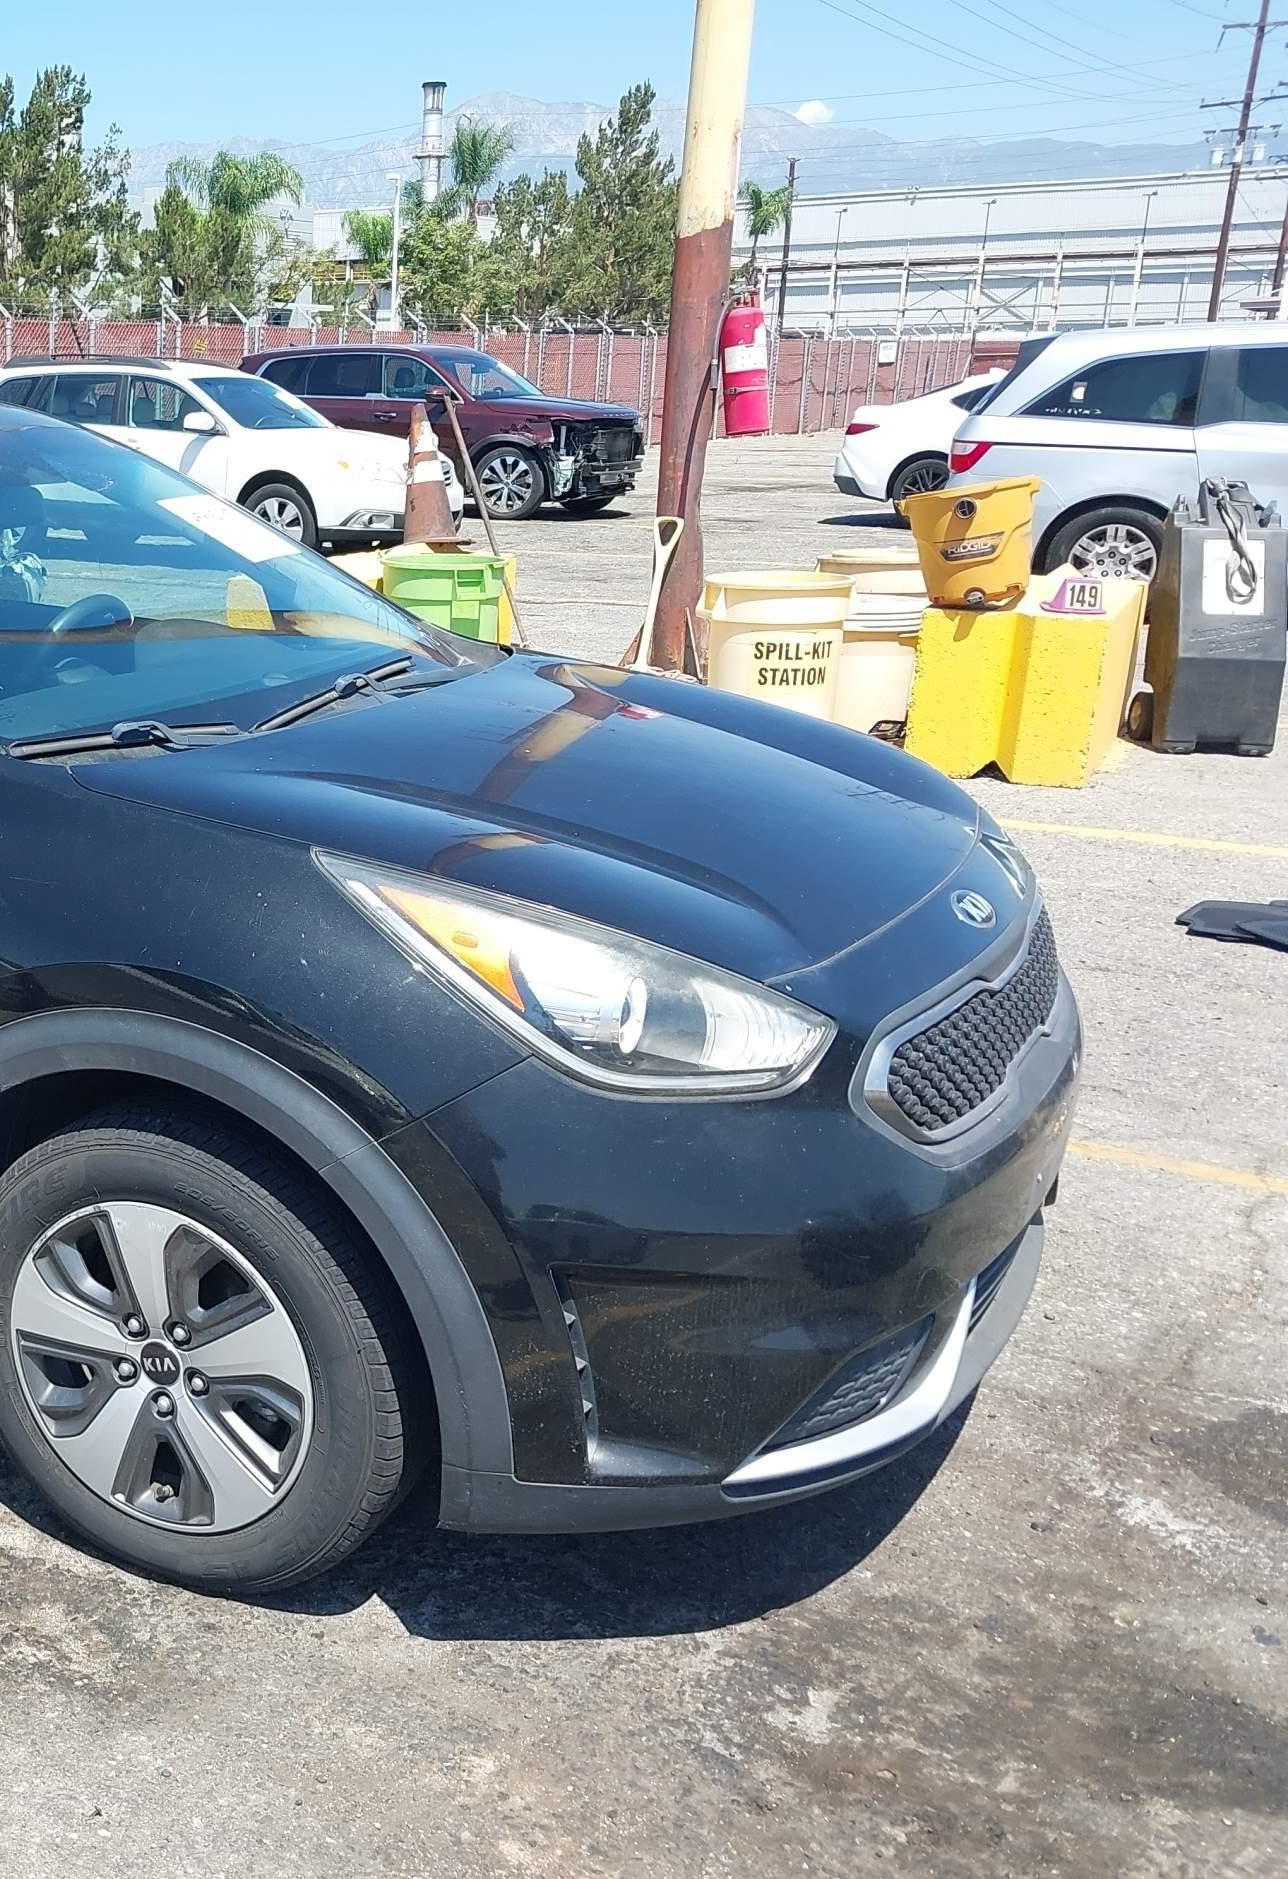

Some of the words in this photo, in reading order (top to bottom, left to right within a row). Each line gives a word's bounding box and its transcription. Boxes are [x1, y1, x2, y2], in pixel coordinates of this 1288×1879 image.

[948, 540, 992, 555] RIDGID
[1070, 584, 1098, 608] 149
[753, 640, 833, 661] SPILL-KIT
[757, 666, 826, 686] STATION
[143, 1357, 176, 1372] KIA
